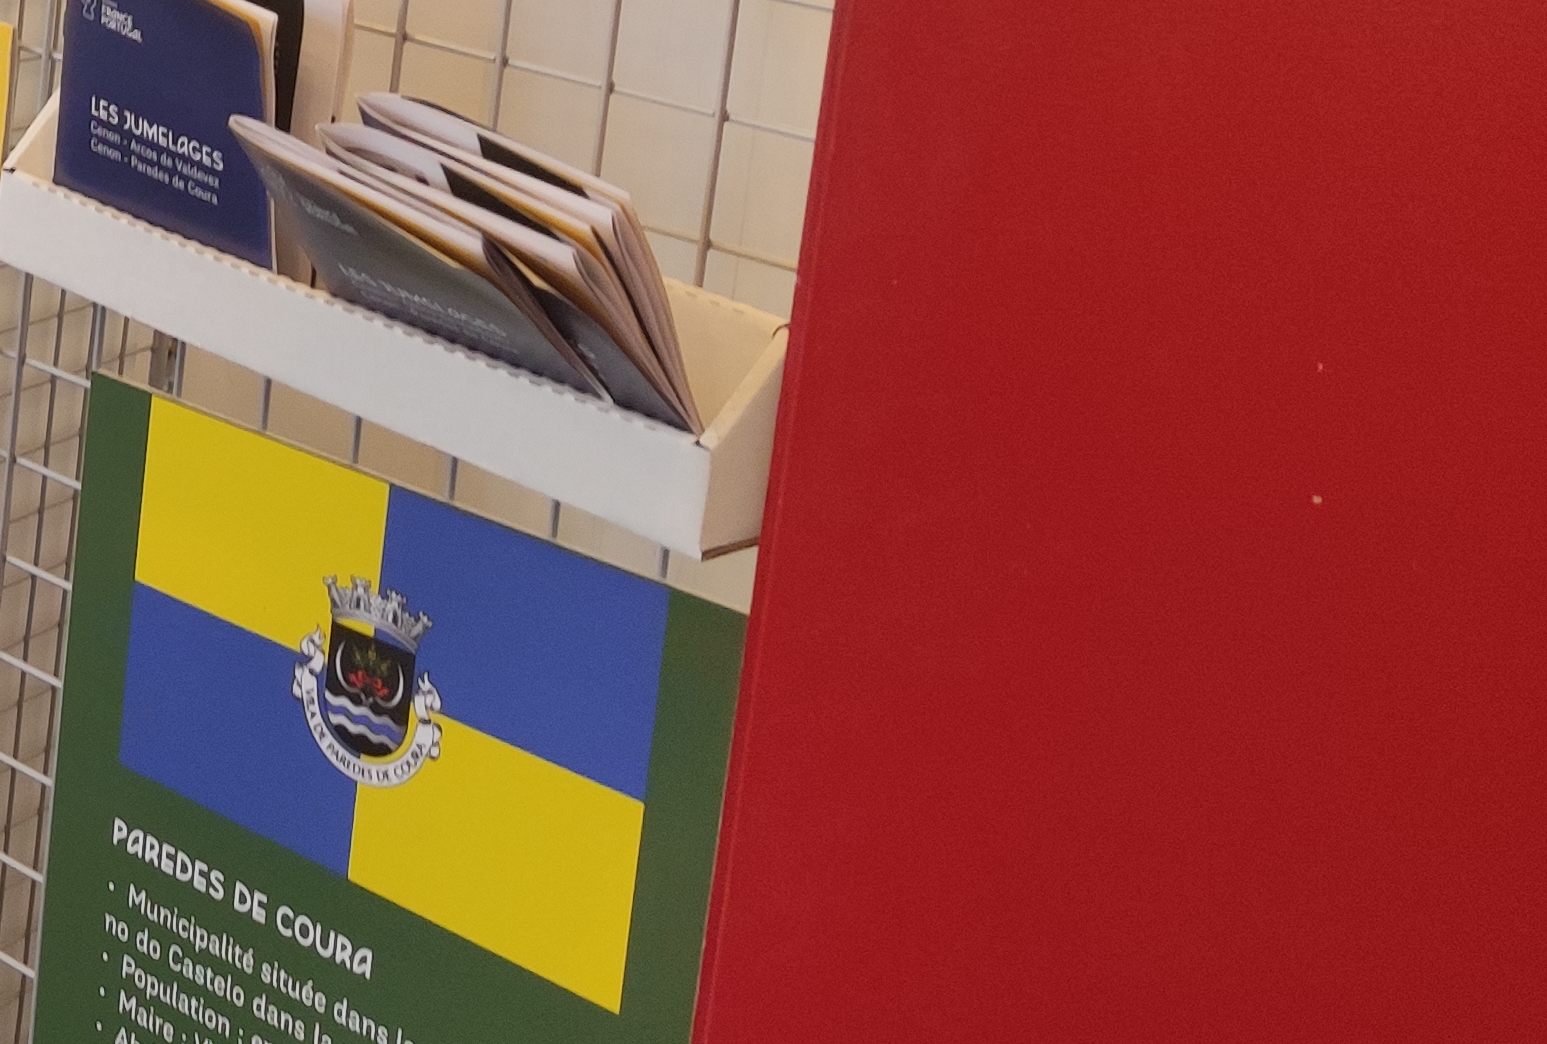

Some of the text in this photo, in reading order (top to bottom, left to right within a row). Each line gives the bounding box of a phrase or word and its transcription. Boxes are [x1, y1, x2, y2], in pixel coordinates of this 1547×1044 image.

[101, 14, 143, 44] PORTUGAL
[90, 119, 121, 146] Cenon
[130, 137, 158, 163] Arcos
[160, 151, 173, 170] de
[175, 156, 220, 190] Valdevez
[90, 136, 122, 163] Cenon
[130, 154, 170, 186] Paredes
[171, 173, 185, 192] de
[188, 178, 219, 206] Coura
[91, 94, 225, 172] LES JUMELAGES
[111, 816, 374, 981] PAREDES DE COURA
[104, 912, 130, 943] no
[136, 927, 162, 961] do
[168, 943, 246, 1008] Castelo
[252, 992, 305, 1042] dans
[121, 952, 231, 1039] Population
[128, 882, 255, 975] Municipalité
[260, 960, 327, 1014] située
[333, 996, 389, 1044] dans
[118, 987, 175, 1044] Maire
